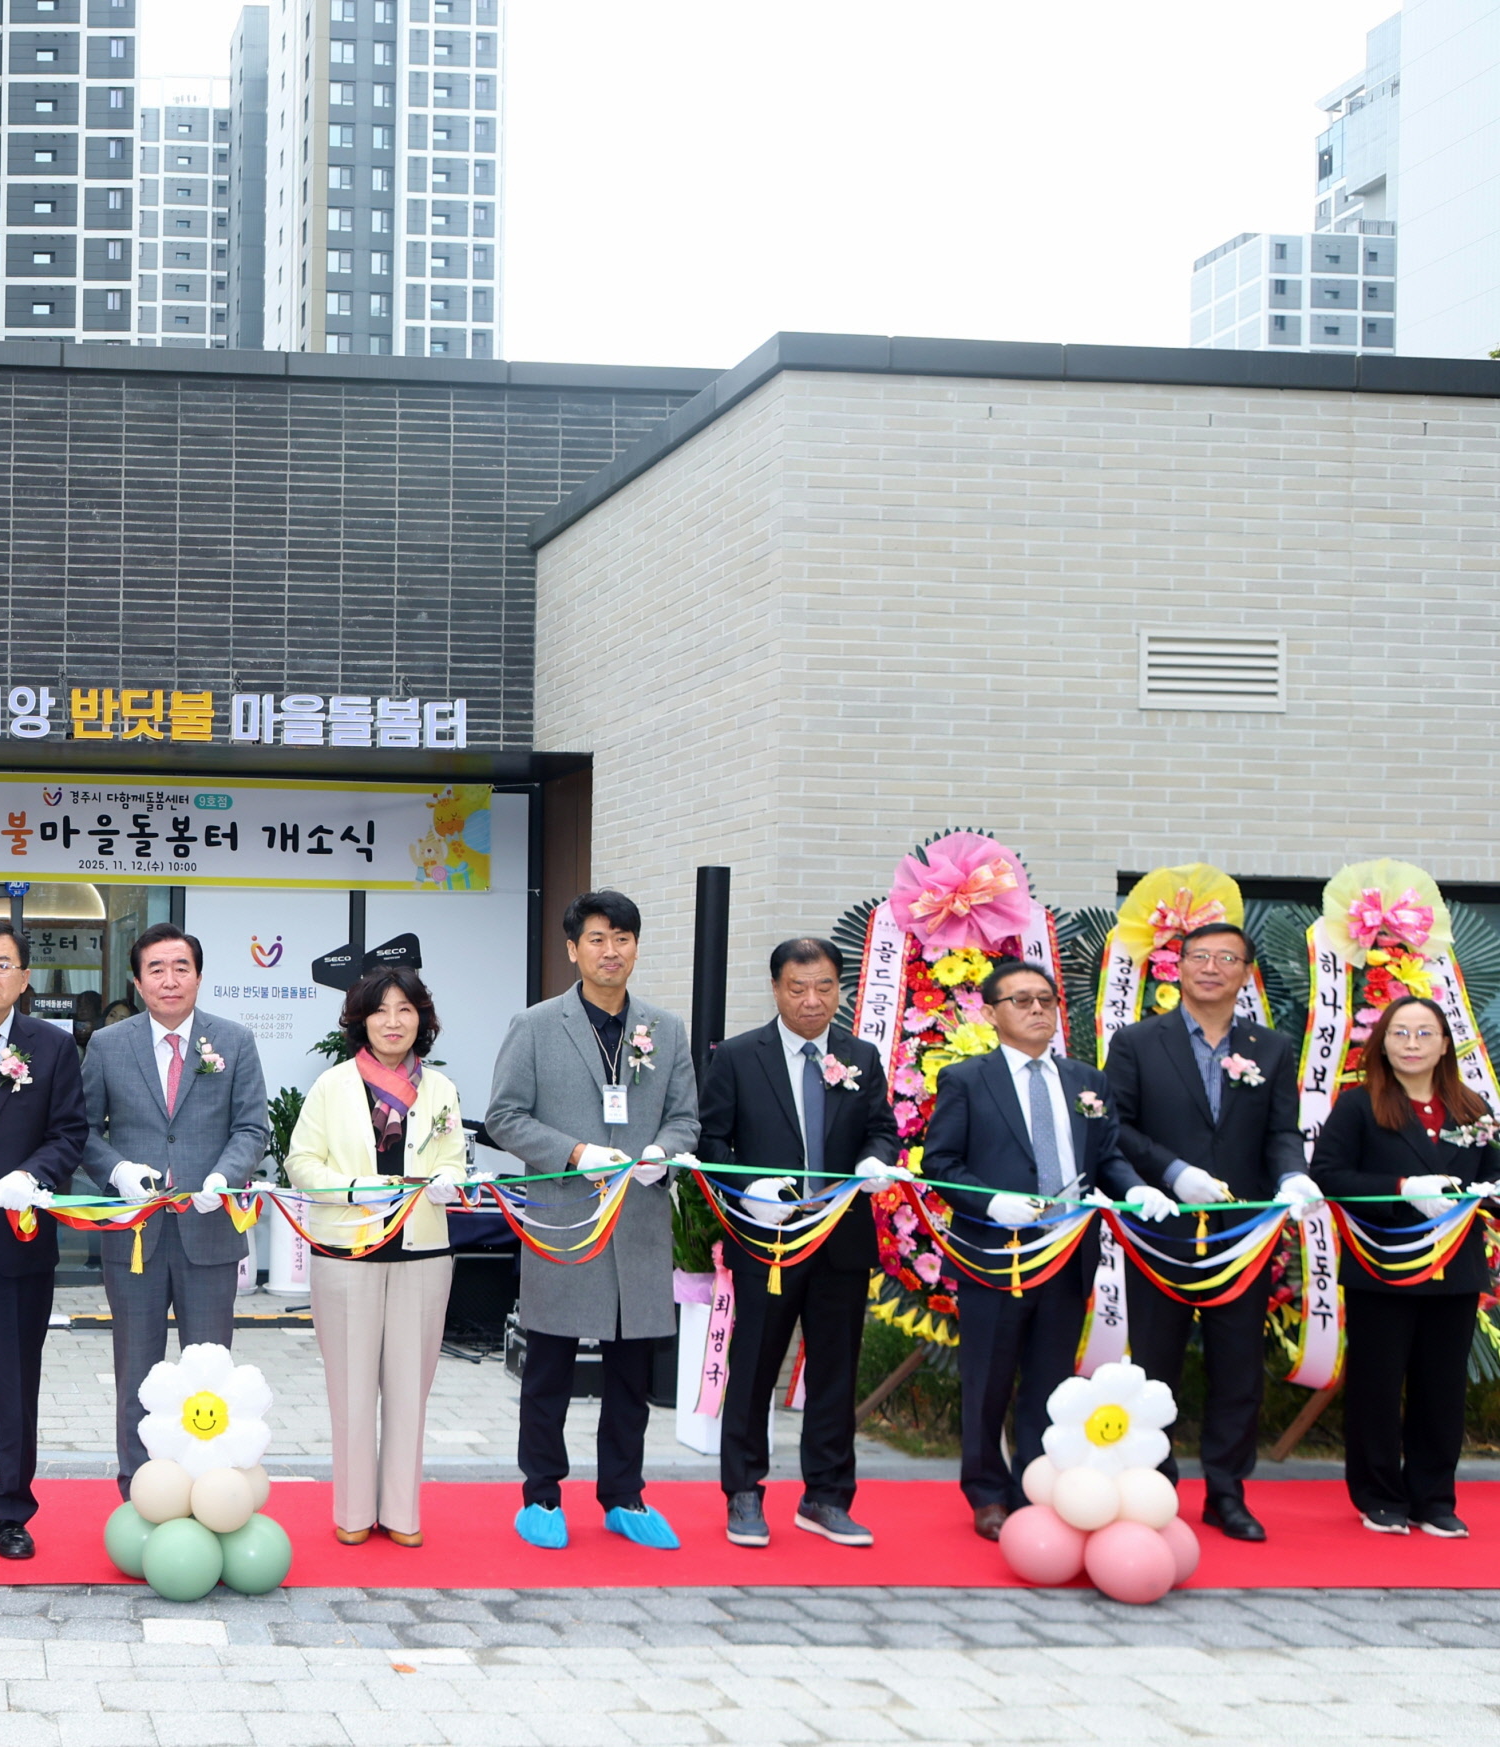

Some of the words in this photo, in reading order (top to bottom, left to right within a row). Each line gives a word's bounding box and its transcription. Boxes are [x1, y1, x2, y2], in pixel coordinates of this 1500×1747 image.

[71, 688, 214, 741] 반딧불
[232, 694, 467, 749] 마을돌봄터
[70, 791, 102, 804] 경주시
[107, 791, 190, 812] 다함께돌봄센터
[199, 795, 228, 808] 9호점
[262, 820, 375, 863] 개소식
[79, 860, 108, 871] 2025.
[113, 860, 127, 871] 11.
[132, 861, 164, 872] 12.(수)
[168, 862, 197, 872] 10:00
[324, 955, 352, 964] SECO
[375, 947, 407, 957] SECO
[213, 985, 241, 998] 데시앙
[243, 986, 269, 999] 반딧불
[272, 986, 317, 999] 마을돌봄터
[864, 941, 898, 1043] 골드클래
[1106, 956, 1134, 1030] 경북장애
[239, 1013, 293, 1021] T.054-624-2877
[245, 1022, 293, 1031] 054-624-2879
[1305, 952, 1342, 1095] 하나정보
[254, 1032, 293, 1040] 4-624-2876
[1308, 1217, 1333, 1331] 김동수
[706, 1293, 731, 1388] 최병국
